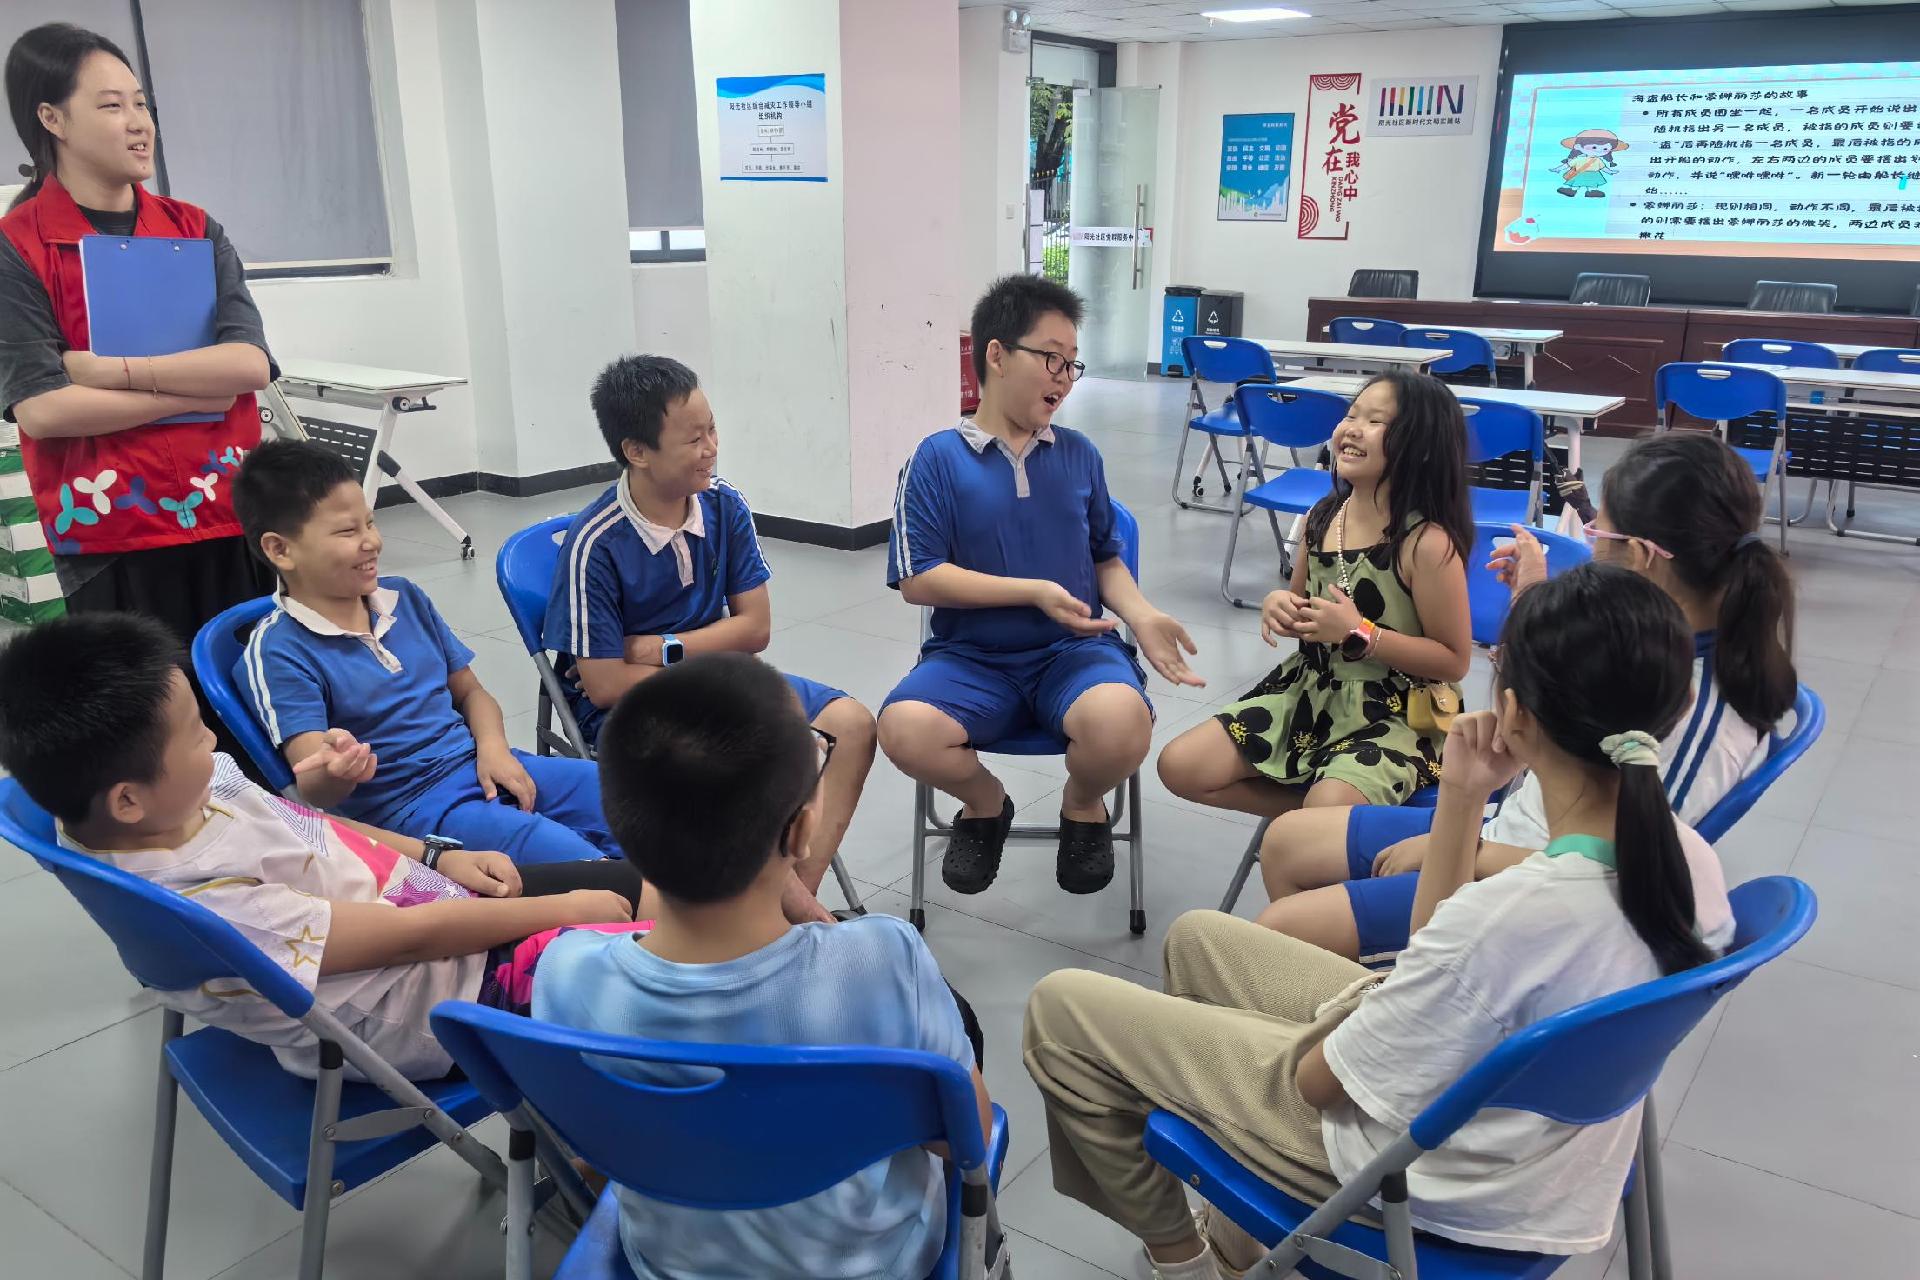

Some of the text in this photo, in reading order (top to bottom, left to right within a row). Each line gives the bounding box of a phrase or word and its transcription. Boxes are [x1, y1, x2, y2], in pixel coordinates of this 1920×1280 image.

[1631, 89, 1808, 103] 海盗船长和蒙娜丽莎的故事
